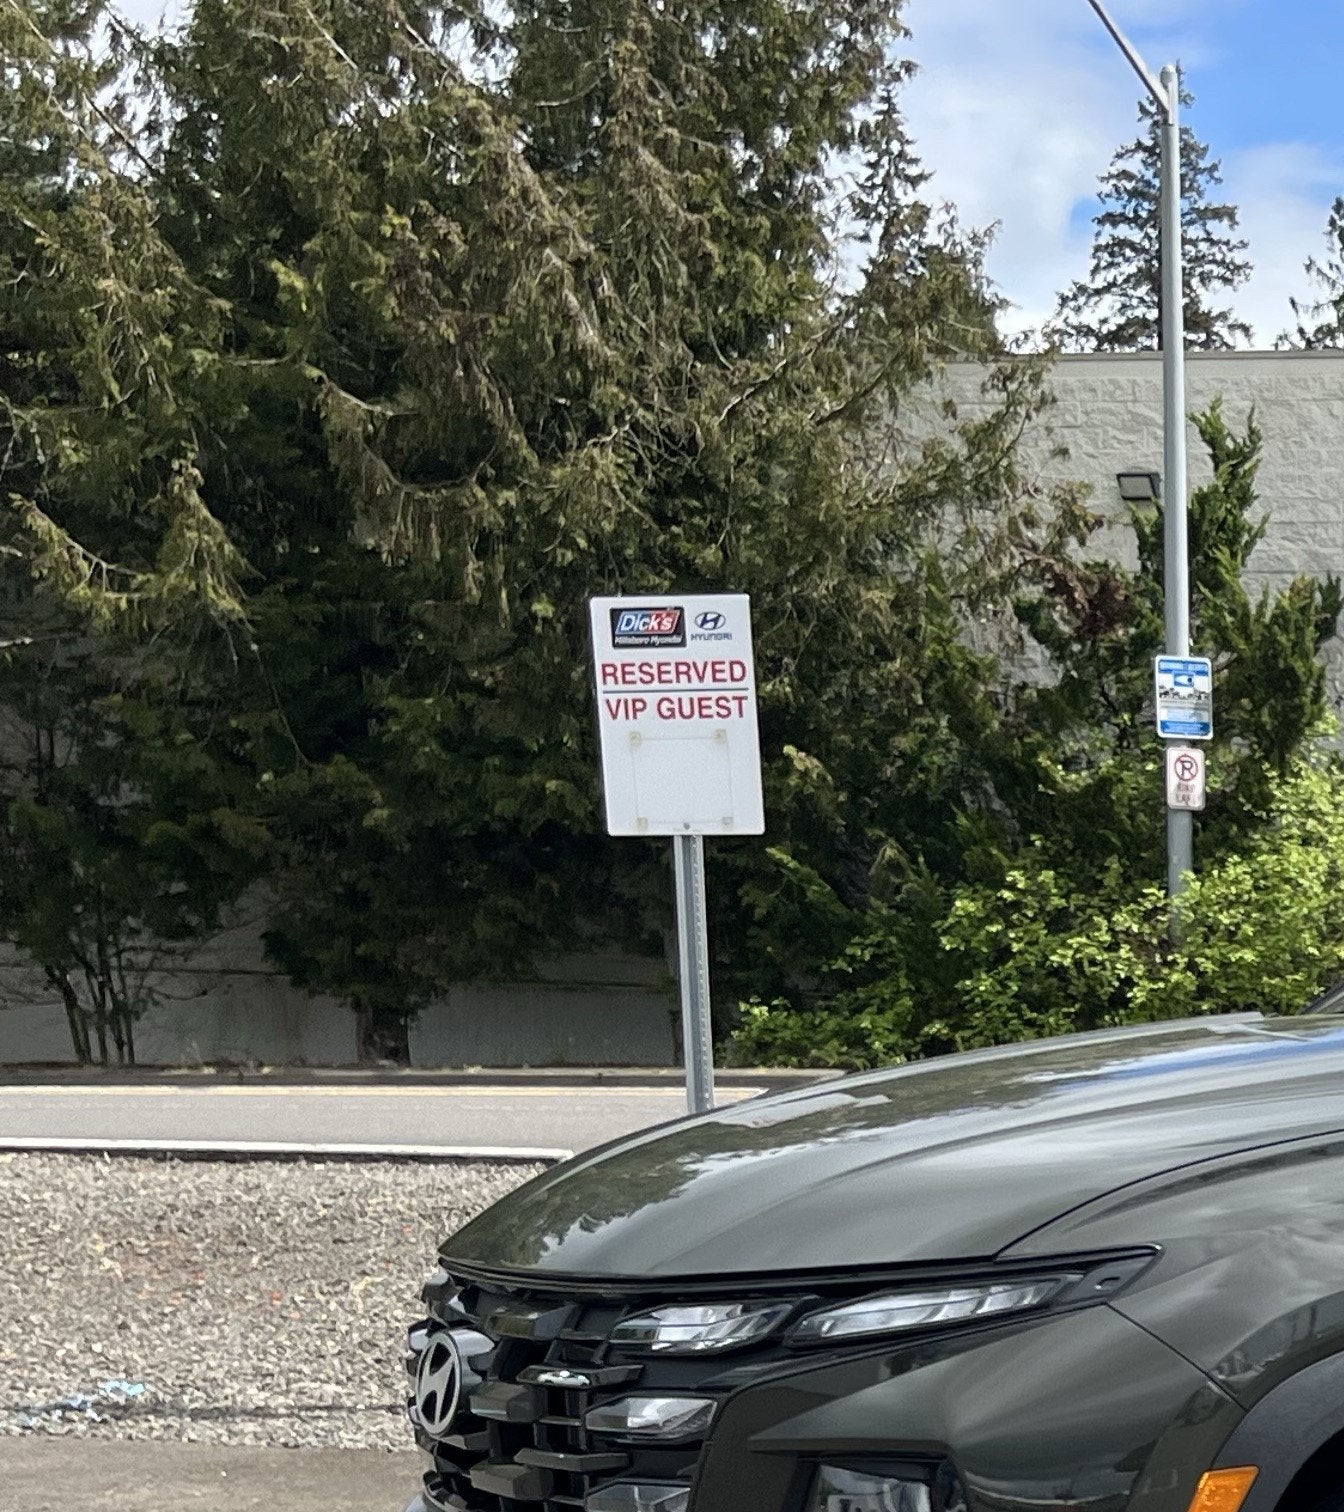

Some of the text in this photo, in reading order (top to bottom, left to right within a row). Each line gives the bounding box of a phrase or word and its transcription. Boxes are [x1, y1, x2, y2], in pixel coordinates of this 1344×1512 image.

[601, 660, 747, 686] RESERVED
[605, 695, 749, 721] VIP GUEST
